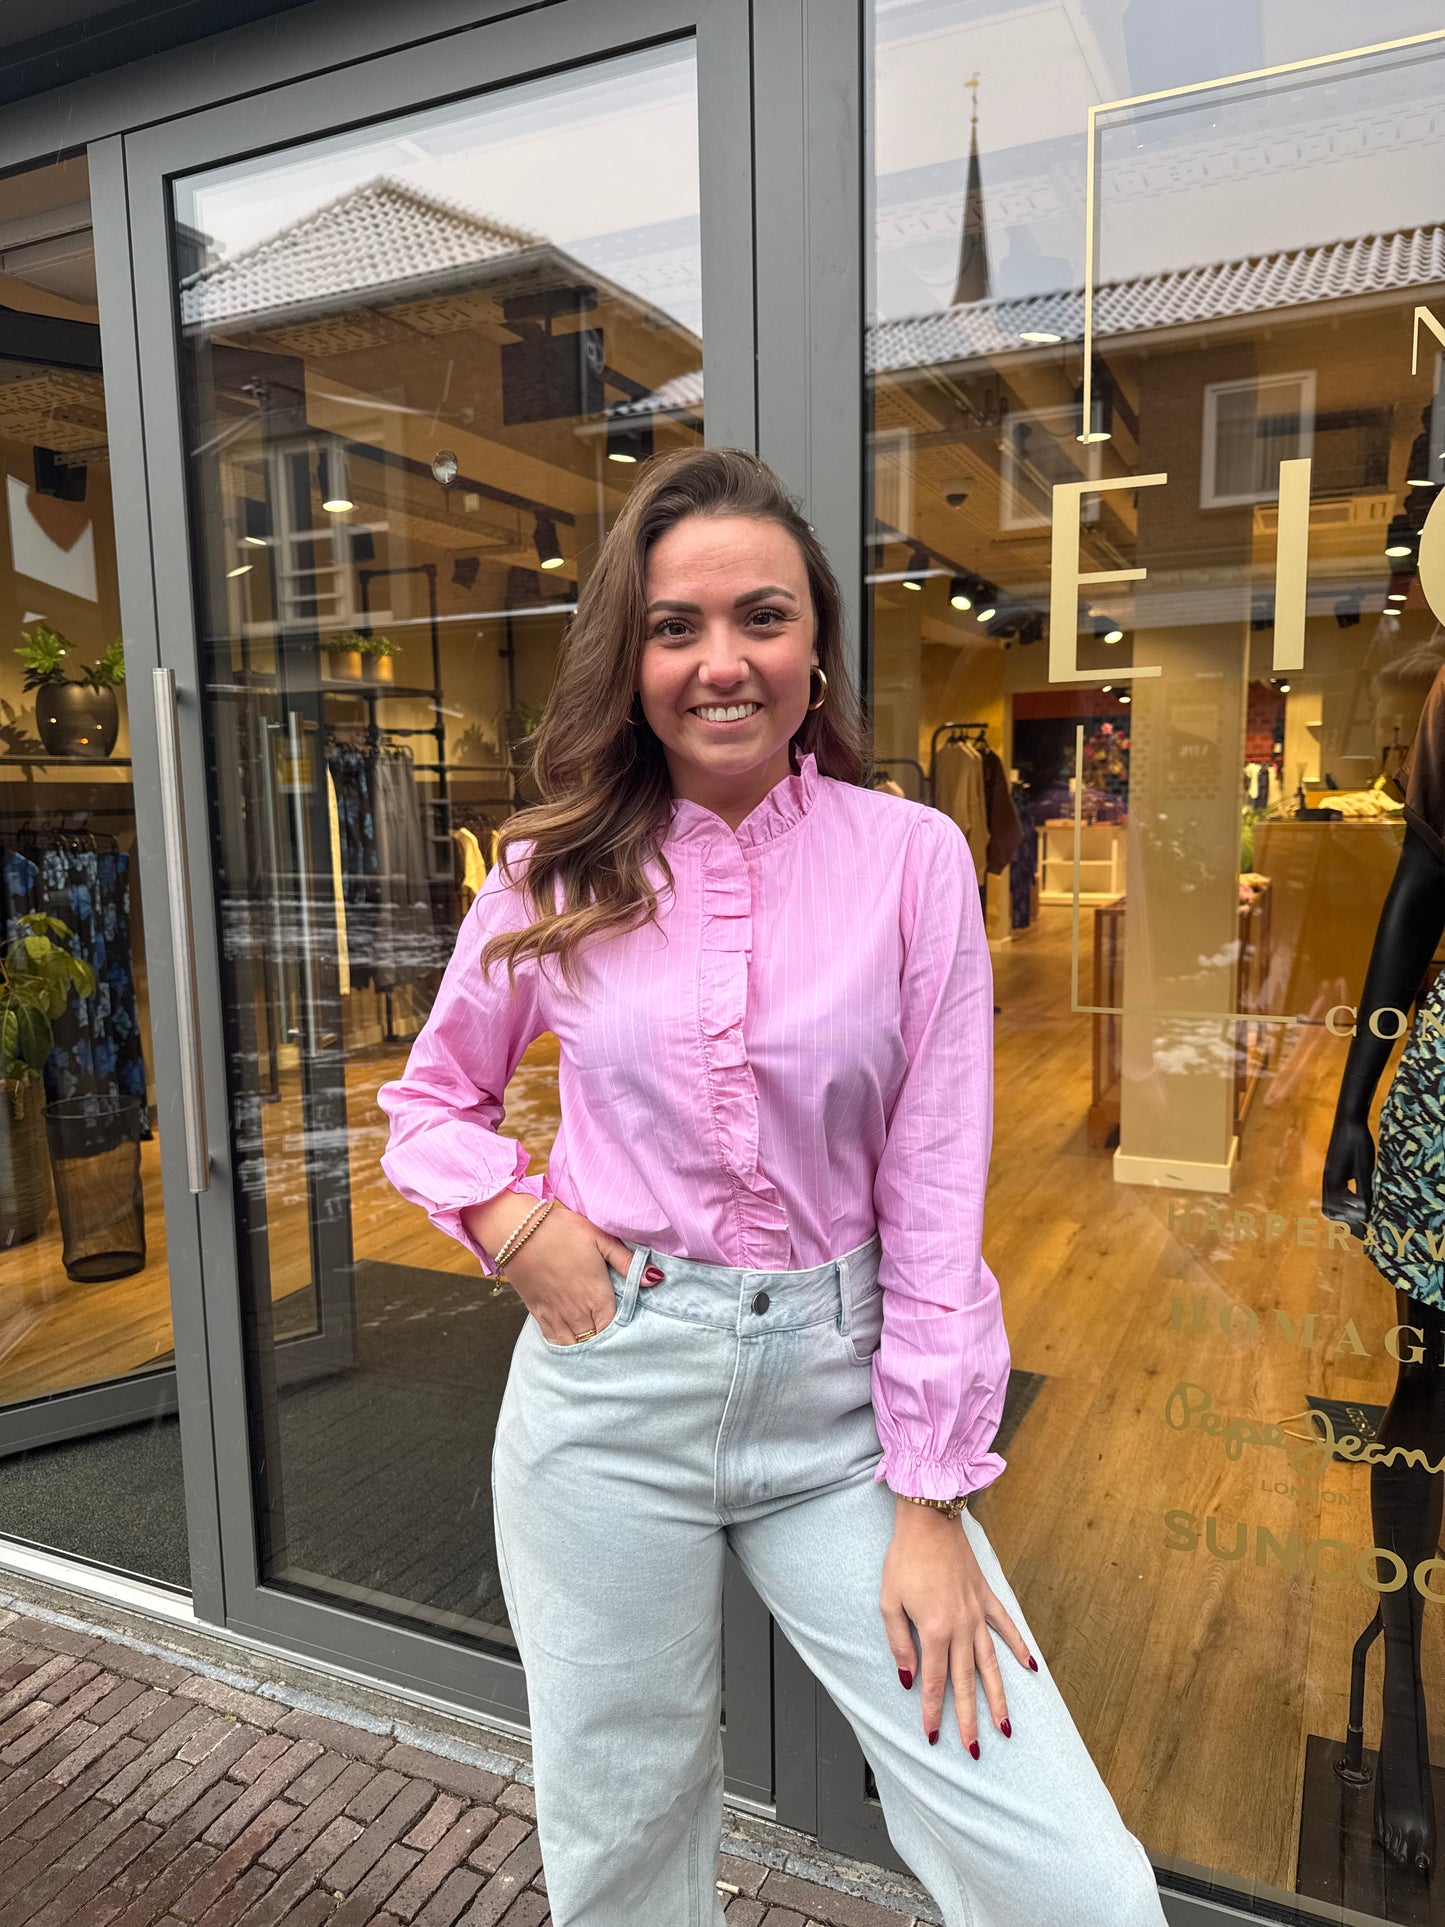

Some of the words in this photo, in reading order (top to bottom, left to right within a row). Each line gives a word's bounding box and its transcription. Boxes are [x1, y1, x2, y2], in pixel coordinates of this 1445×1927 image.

[1048, 457, 1445, 683] EI
[1170, 1297, 1445, 1369] HOMAG
[1165, 1381, 1287, 1461] Pepe
[1294, 1409, 1445, 1477] Jean
[1261, 1480, 1352, 1505] LONON
